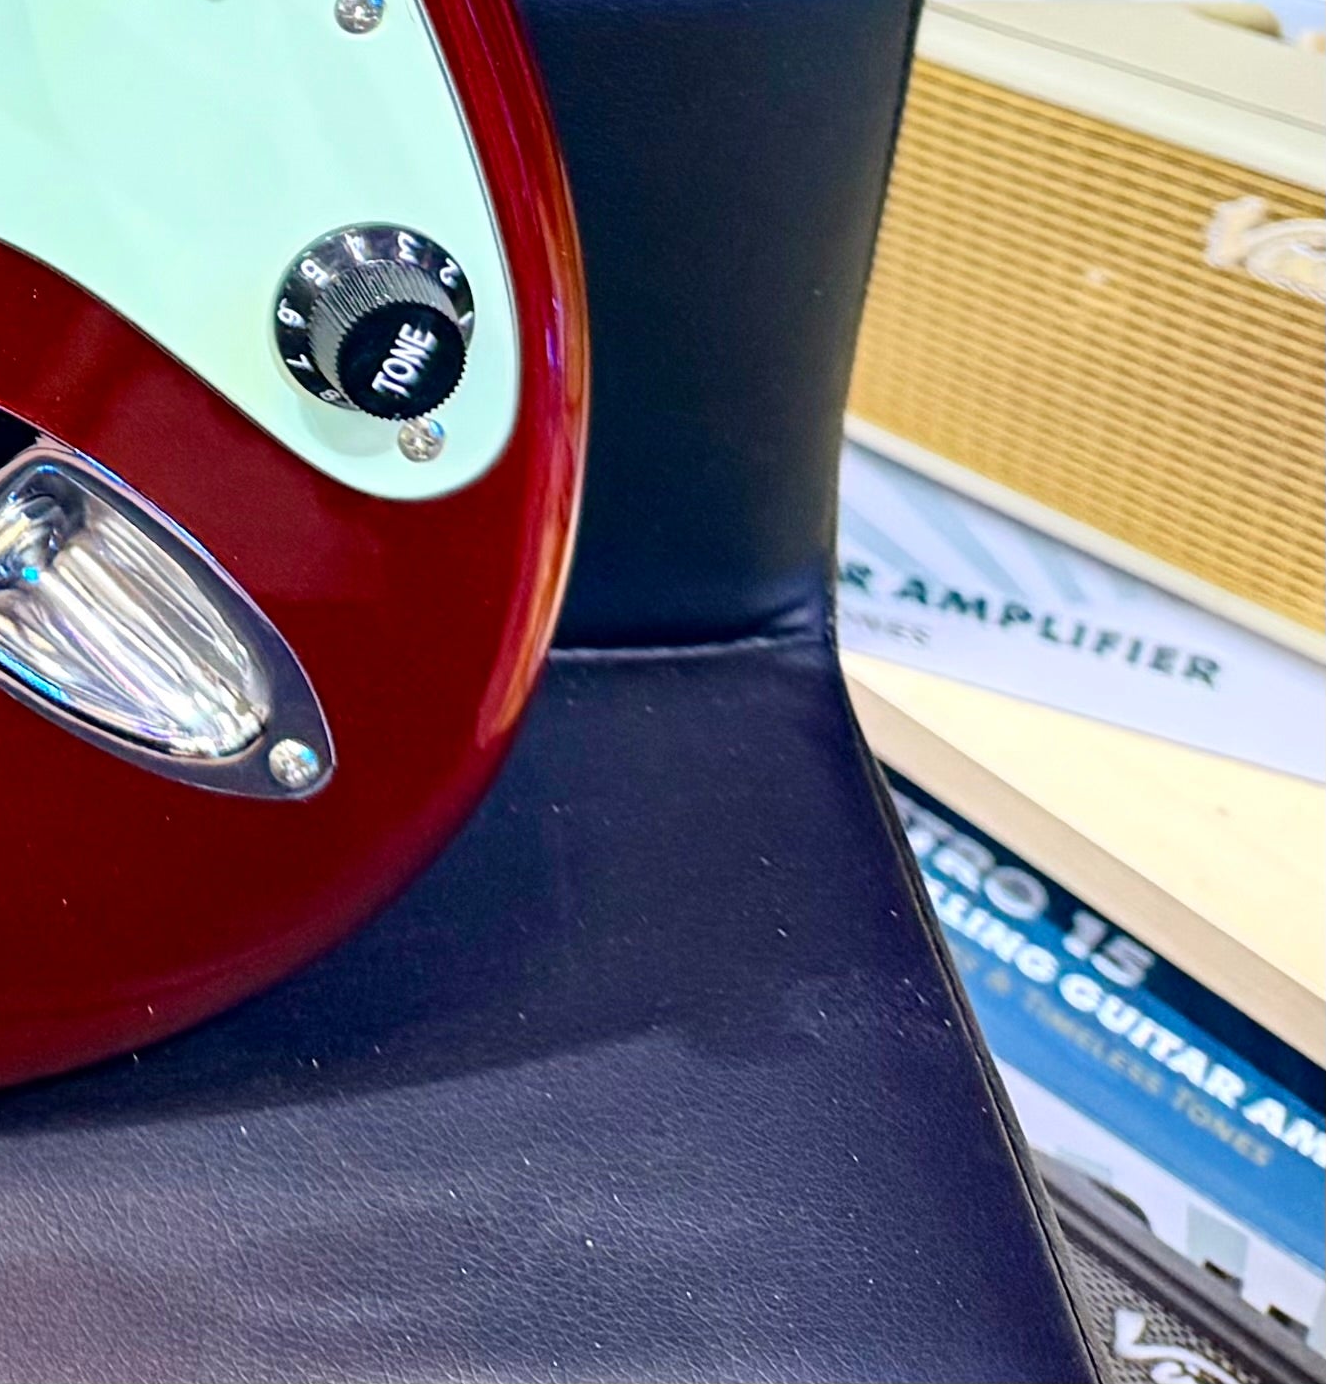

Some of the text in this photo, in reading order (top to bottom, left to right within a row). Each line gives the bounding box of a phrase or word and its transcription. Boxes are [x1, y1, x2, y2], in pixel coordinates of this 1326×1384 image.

[439, 257, 462, 289] 2
[371, 322, 439, 399] TONE
[892, 573, 1223, 692] AMPLIFIER
[1062, 911, 1155, 989] 15
[1059, 973, 1246, 1109] GUITAR
[1172, 1084, 1274, 1167] TONES
